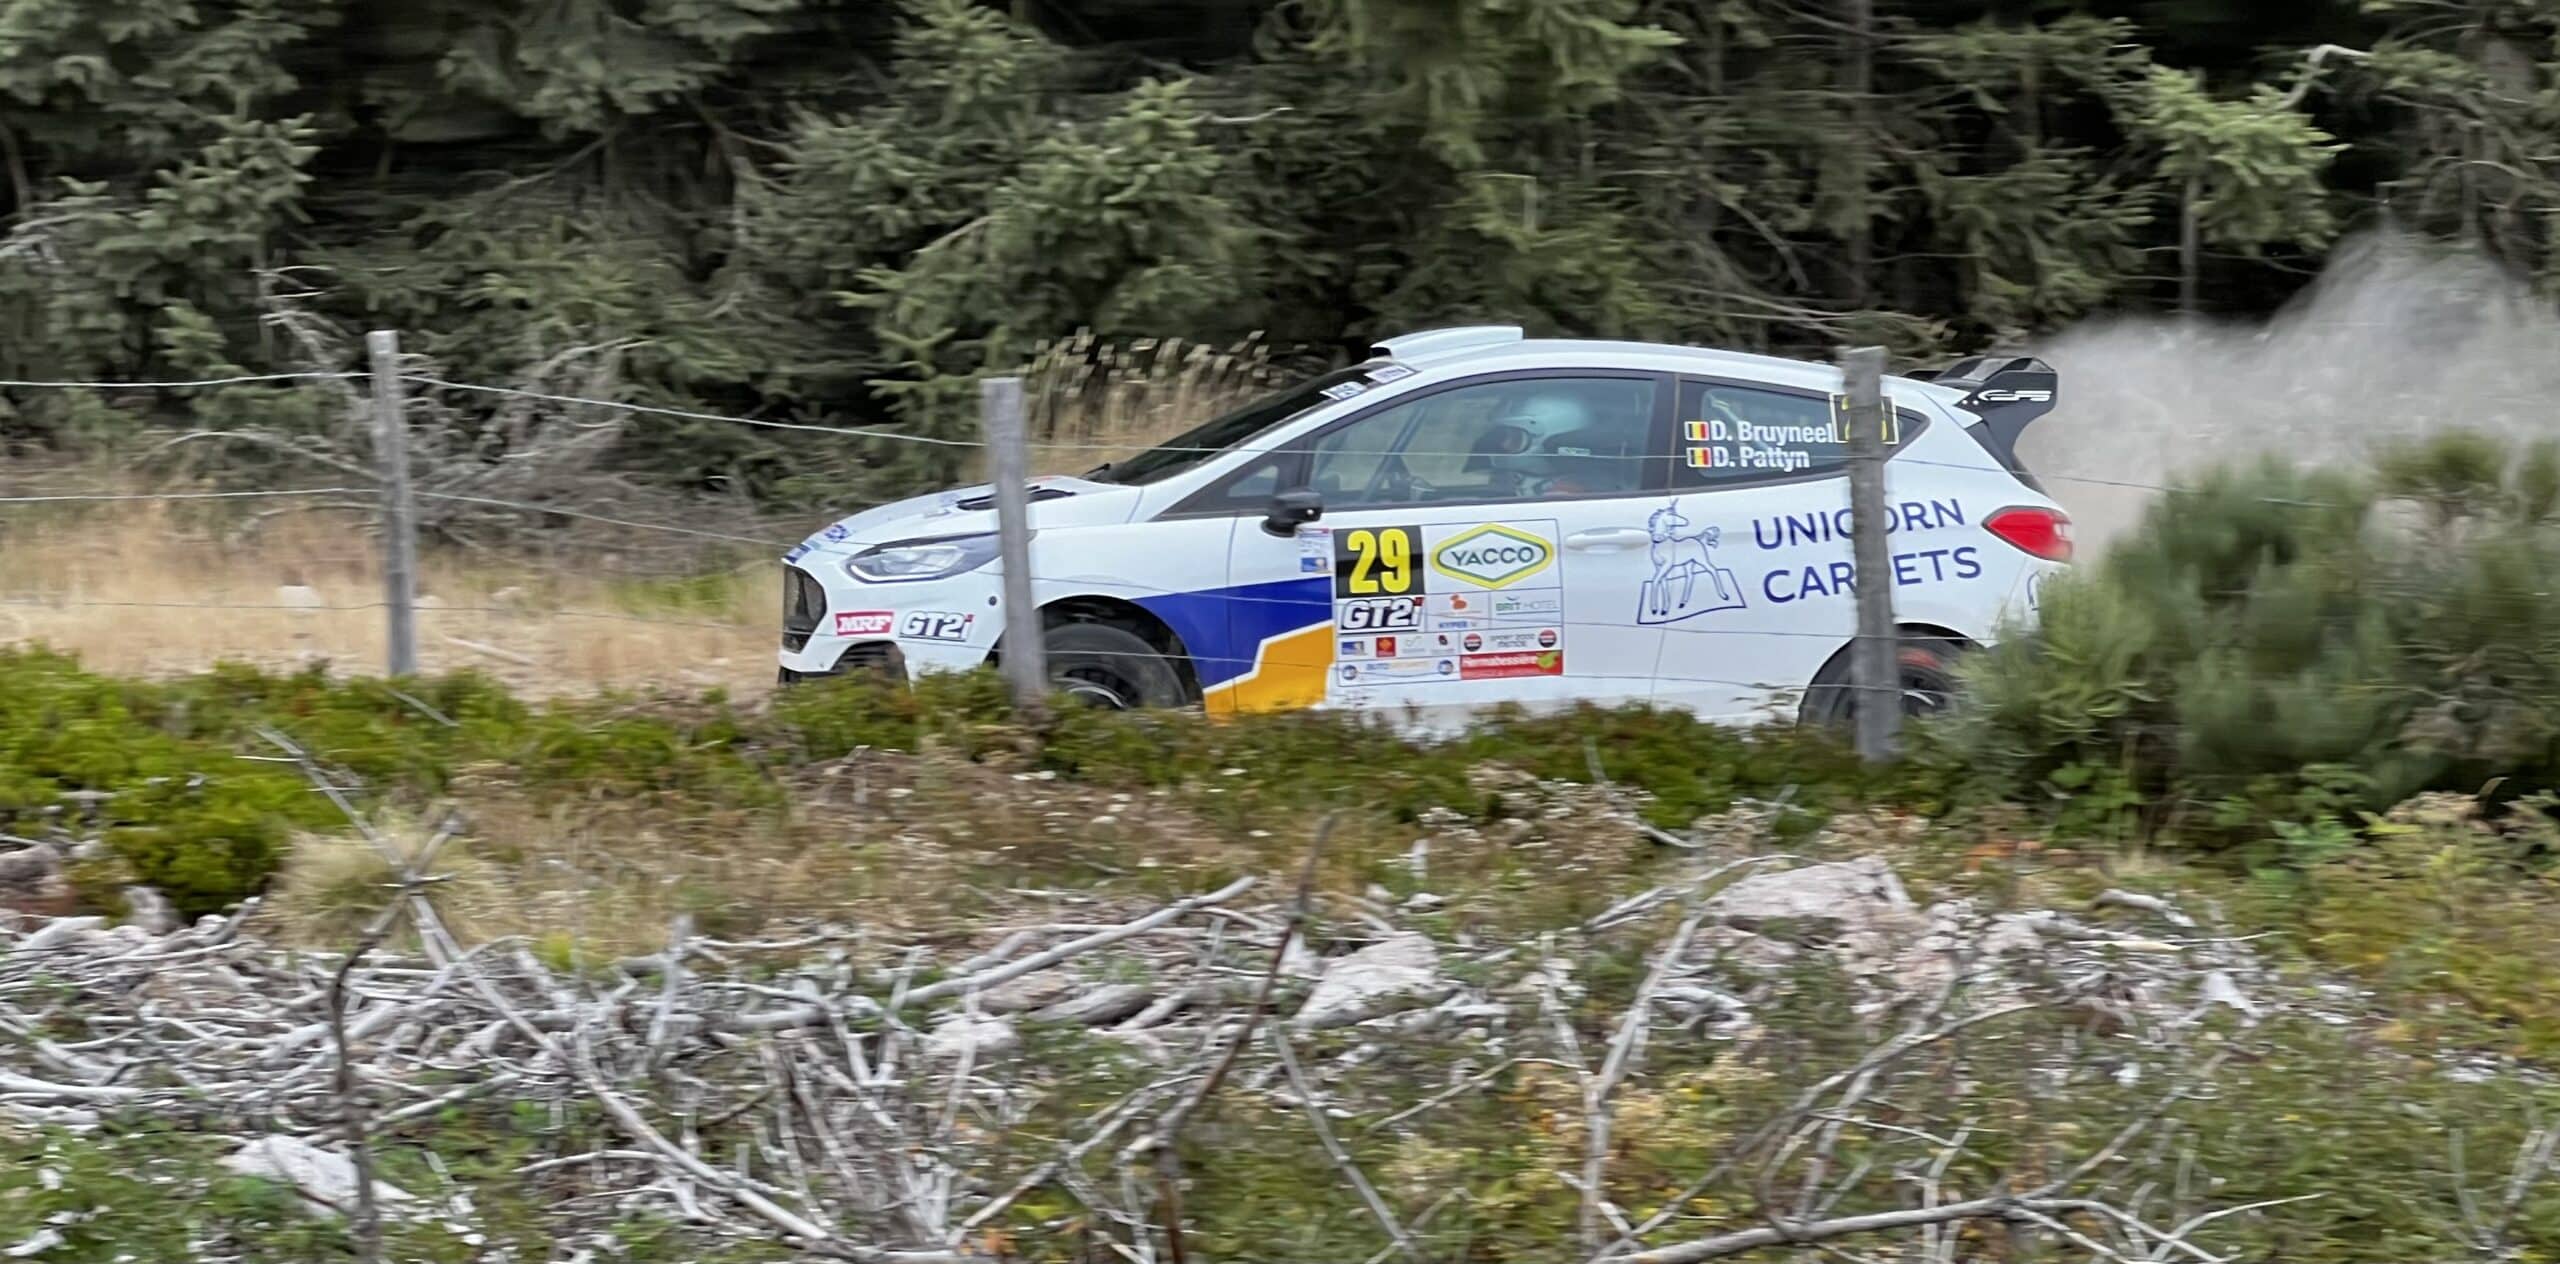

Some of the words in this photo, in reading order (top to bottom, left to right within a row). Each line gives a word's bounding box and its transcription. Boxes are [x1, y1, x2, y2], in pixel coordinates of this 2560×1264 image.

[1710, 421, 1732, 441] D.
[1737, 421, 1836, 446] Bruyneel
[1714, 447, 1735, 467] D.
[1740, 450, 1811, 472] Pattyn
[1347, 528, 1411, 594] 29
[1451, 546, 1534, 566] YACCO
[1763, 546, 1981, 603] CARETS
[838, 614, 891, 633] MRF
[901, 611, 975, 641] GT2i
[1342, 597, 1424, 630] GT2i
